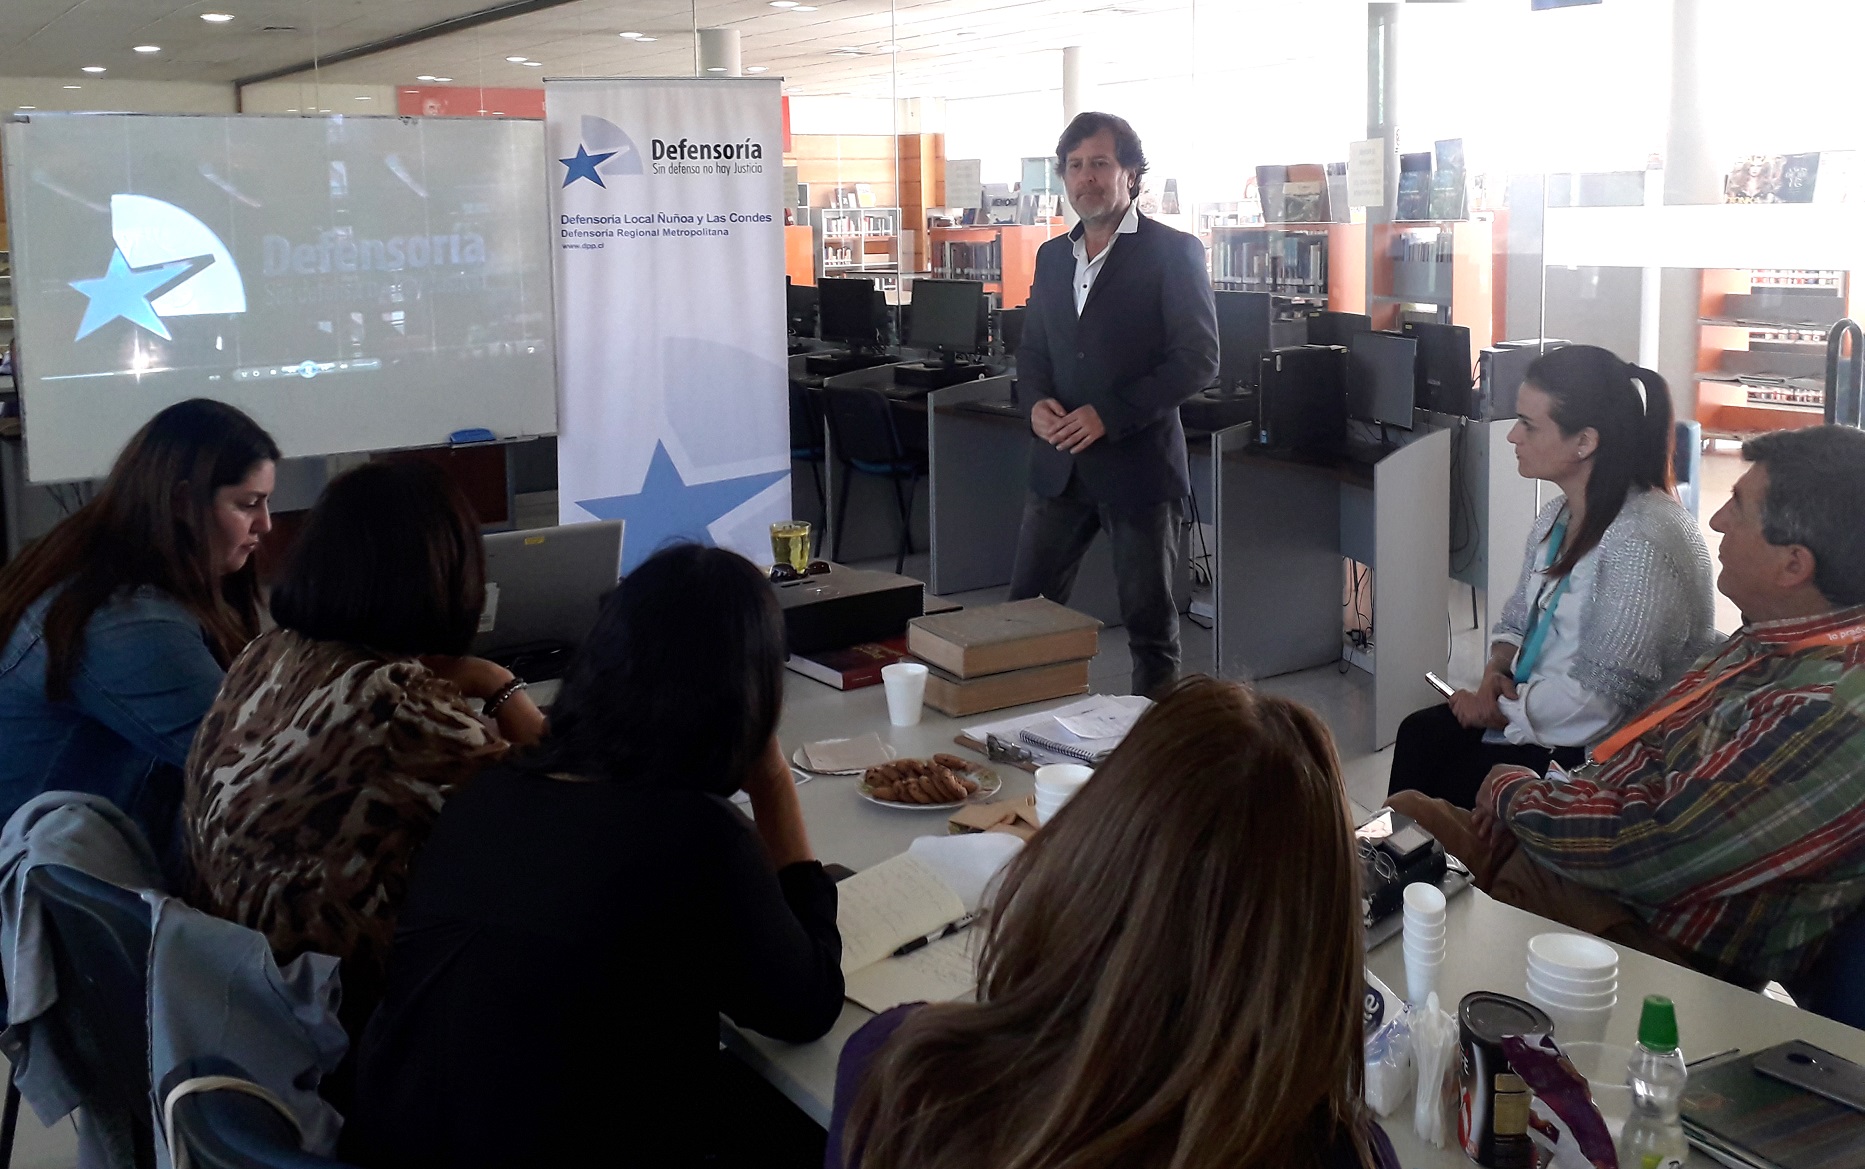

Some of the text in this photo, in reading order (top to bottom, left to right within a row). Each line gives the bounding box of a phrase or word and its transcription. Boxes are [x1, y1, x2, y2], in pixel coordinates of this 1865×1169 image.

[652, 138, 762, 160] Defensoría
[652, 162, 763, 176] Sin defensa no hay Justicia
[561, 212, 772, 225] Defensoría Local Ñuñoa y Las Condes
[561, 228, 729, 239] Defensoría Regional Metropolitana
